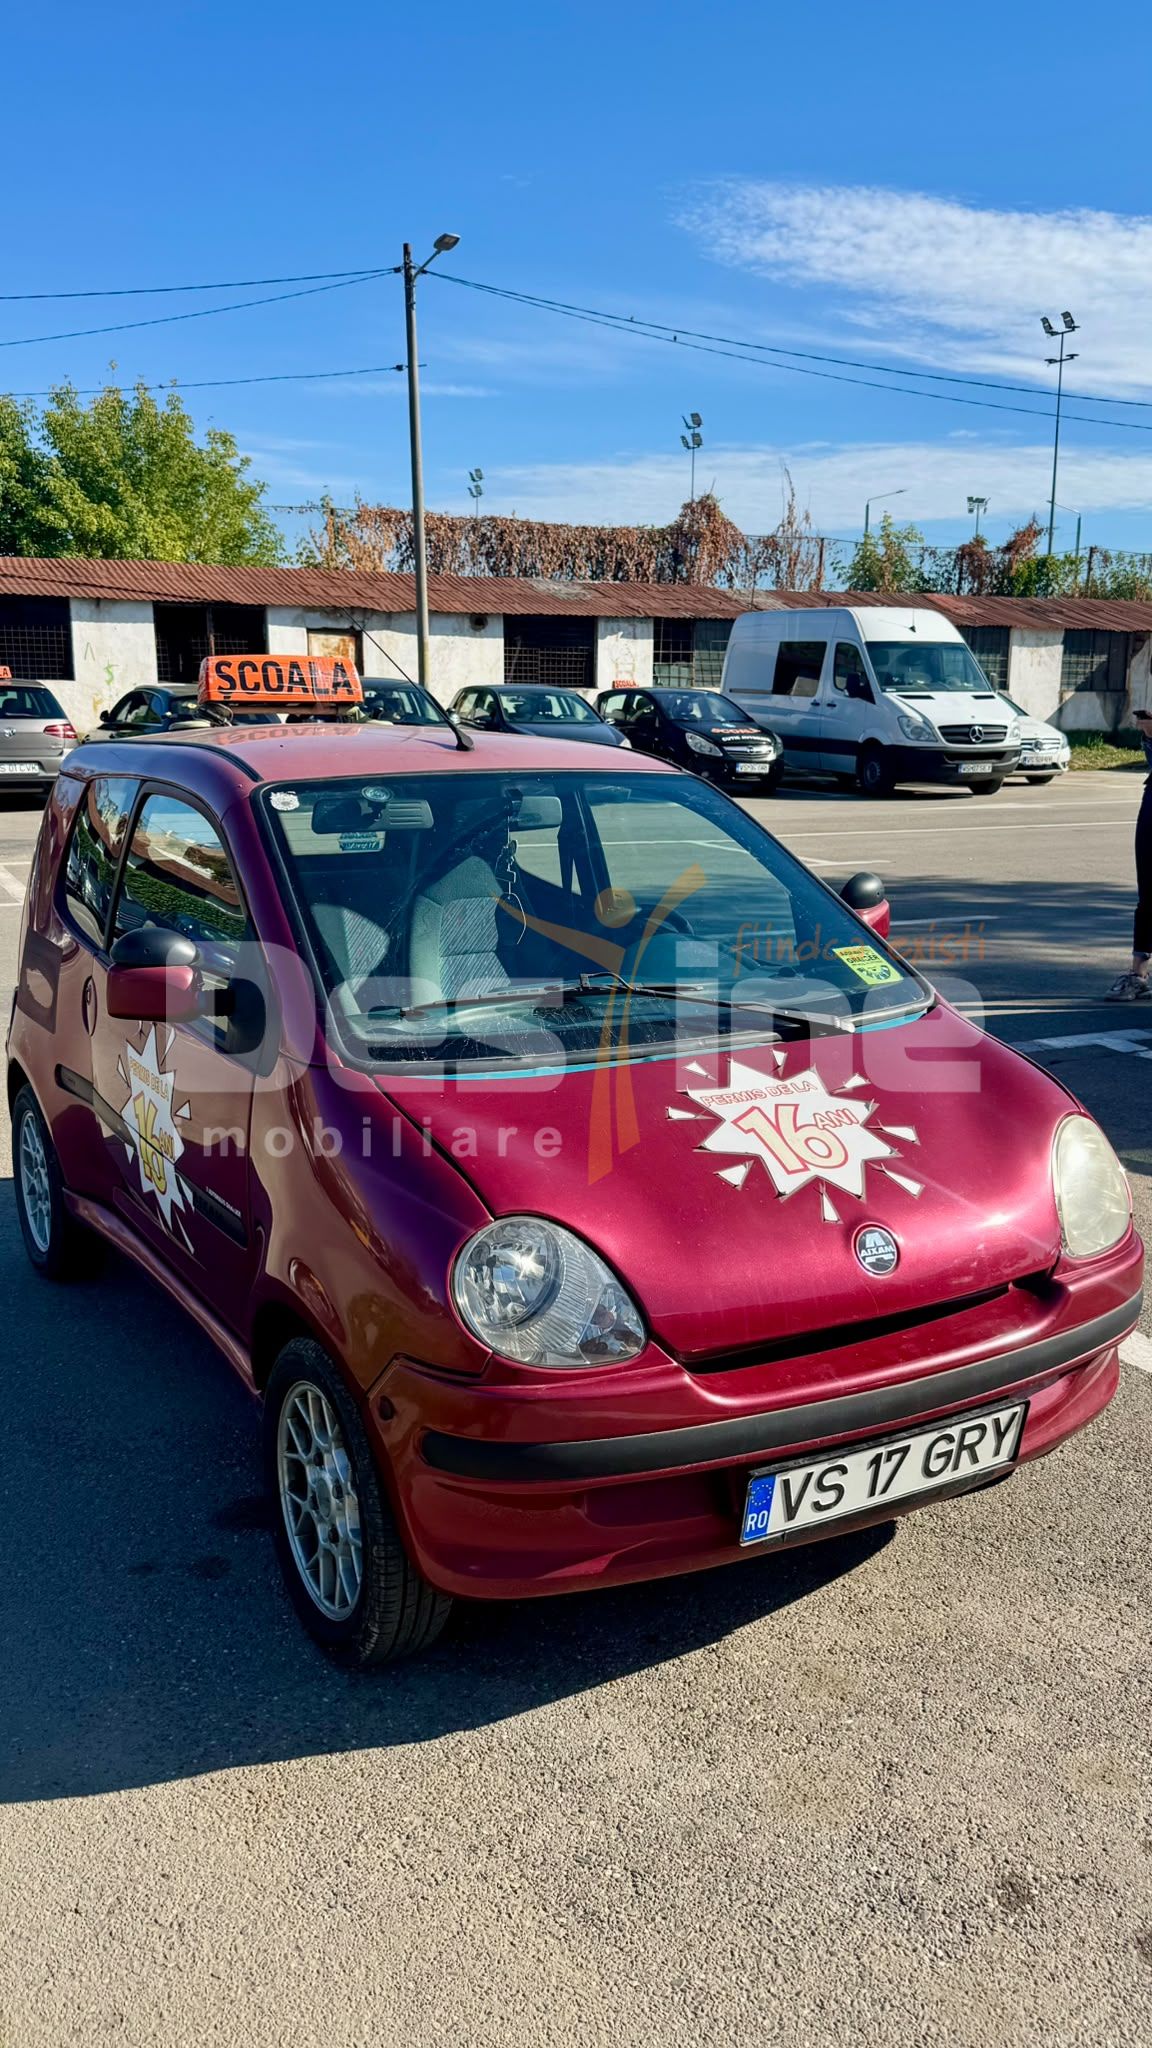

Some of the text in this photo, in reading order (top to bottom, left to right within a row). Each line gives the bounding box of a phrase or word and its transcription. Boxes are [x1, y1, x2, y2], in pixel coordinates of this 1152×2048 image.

[700, 1080, 817, 1107] PERMIS DE LA
[813, 1108, 859, 1129] ANI
[731, 1103, 848, 1175] 16
[861, 1245, 895, 1257] AIXAM
[780, 1411, 1020, 1522] VS 17 GRY
[746, 1510, 769, 1533] RO
